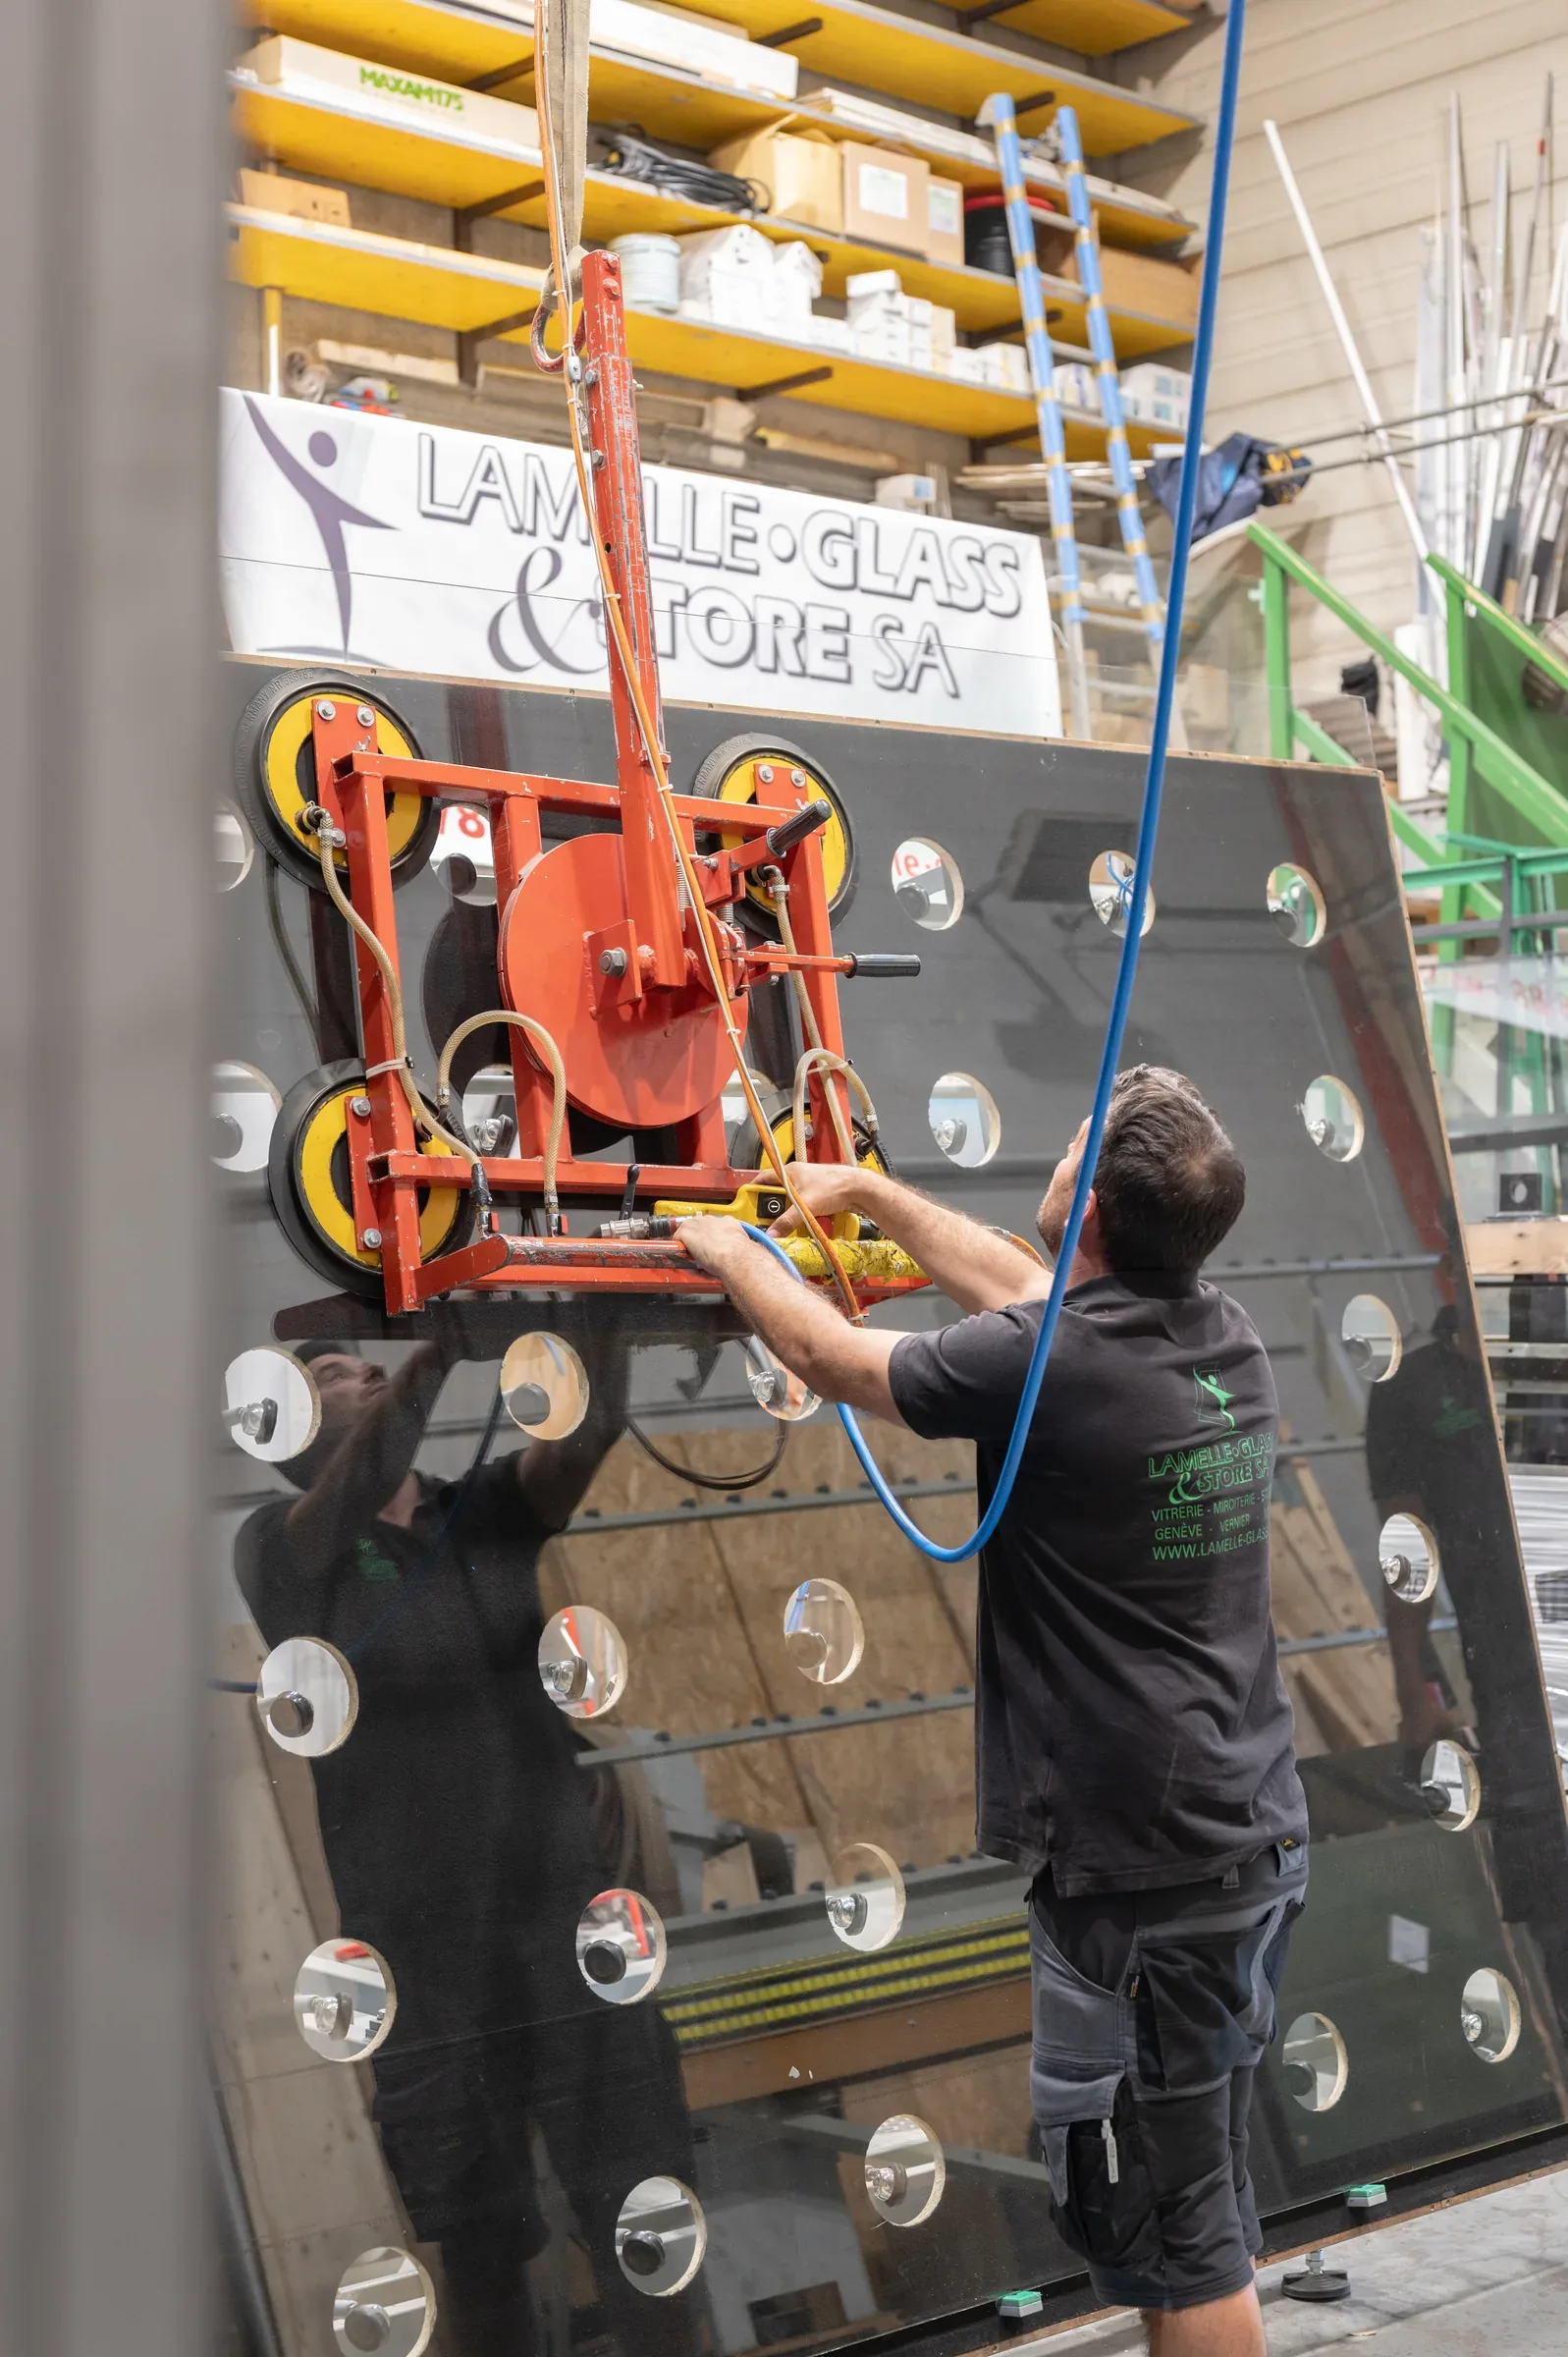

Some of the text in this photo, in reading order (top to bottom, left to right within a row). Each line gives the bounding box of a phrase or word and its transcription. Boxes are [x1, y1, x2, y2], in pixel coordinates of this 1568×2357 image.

[418, 432, 760, 576] LAMLLE
[594, 574, 851, 685] TORE
[872, 614, 960, 698] SA
[1152, 1504, 1204, 1522] VITRERIE
[1213, 1493, 1255, 1514] MIROITERIE
[1155, 1513, 1250, 1540] GENÈVE VERNIER
